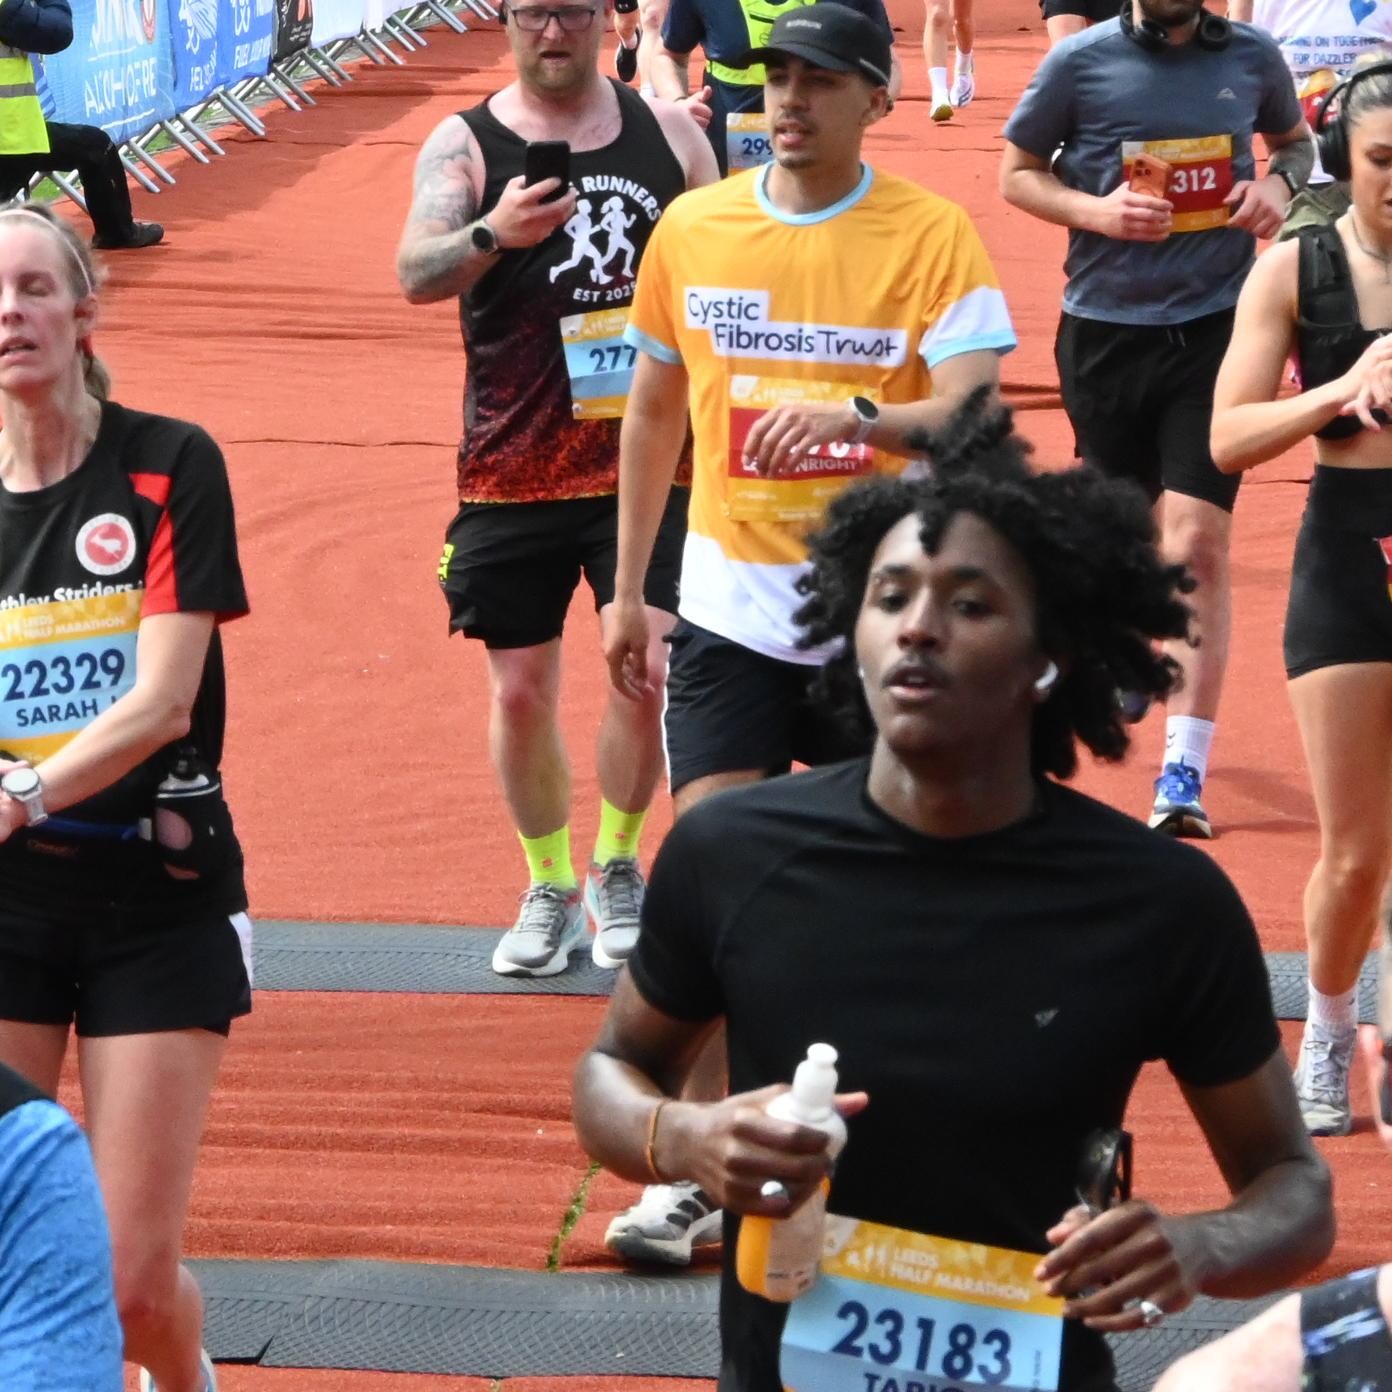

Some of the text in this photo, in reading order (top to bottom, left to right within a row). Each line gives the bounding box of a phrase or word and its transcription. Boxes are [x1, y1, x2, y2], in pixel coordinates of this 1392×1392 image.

[573, 288, 601, 303] EST
[688, 293, 761, 325] Cystic
[714, 323, 899, 358] Fibrosis Trust
[53, 580, 135, 603] Striders
[1, 648, 126, 702] 22329
[16, 698, 99, 727] SARAH
[894, 1247, 940, 1269] LEEDS
[890, 1263, 1031, 1302] HALF MARATHON
[829, 1300, 1013, 1386] 23183
